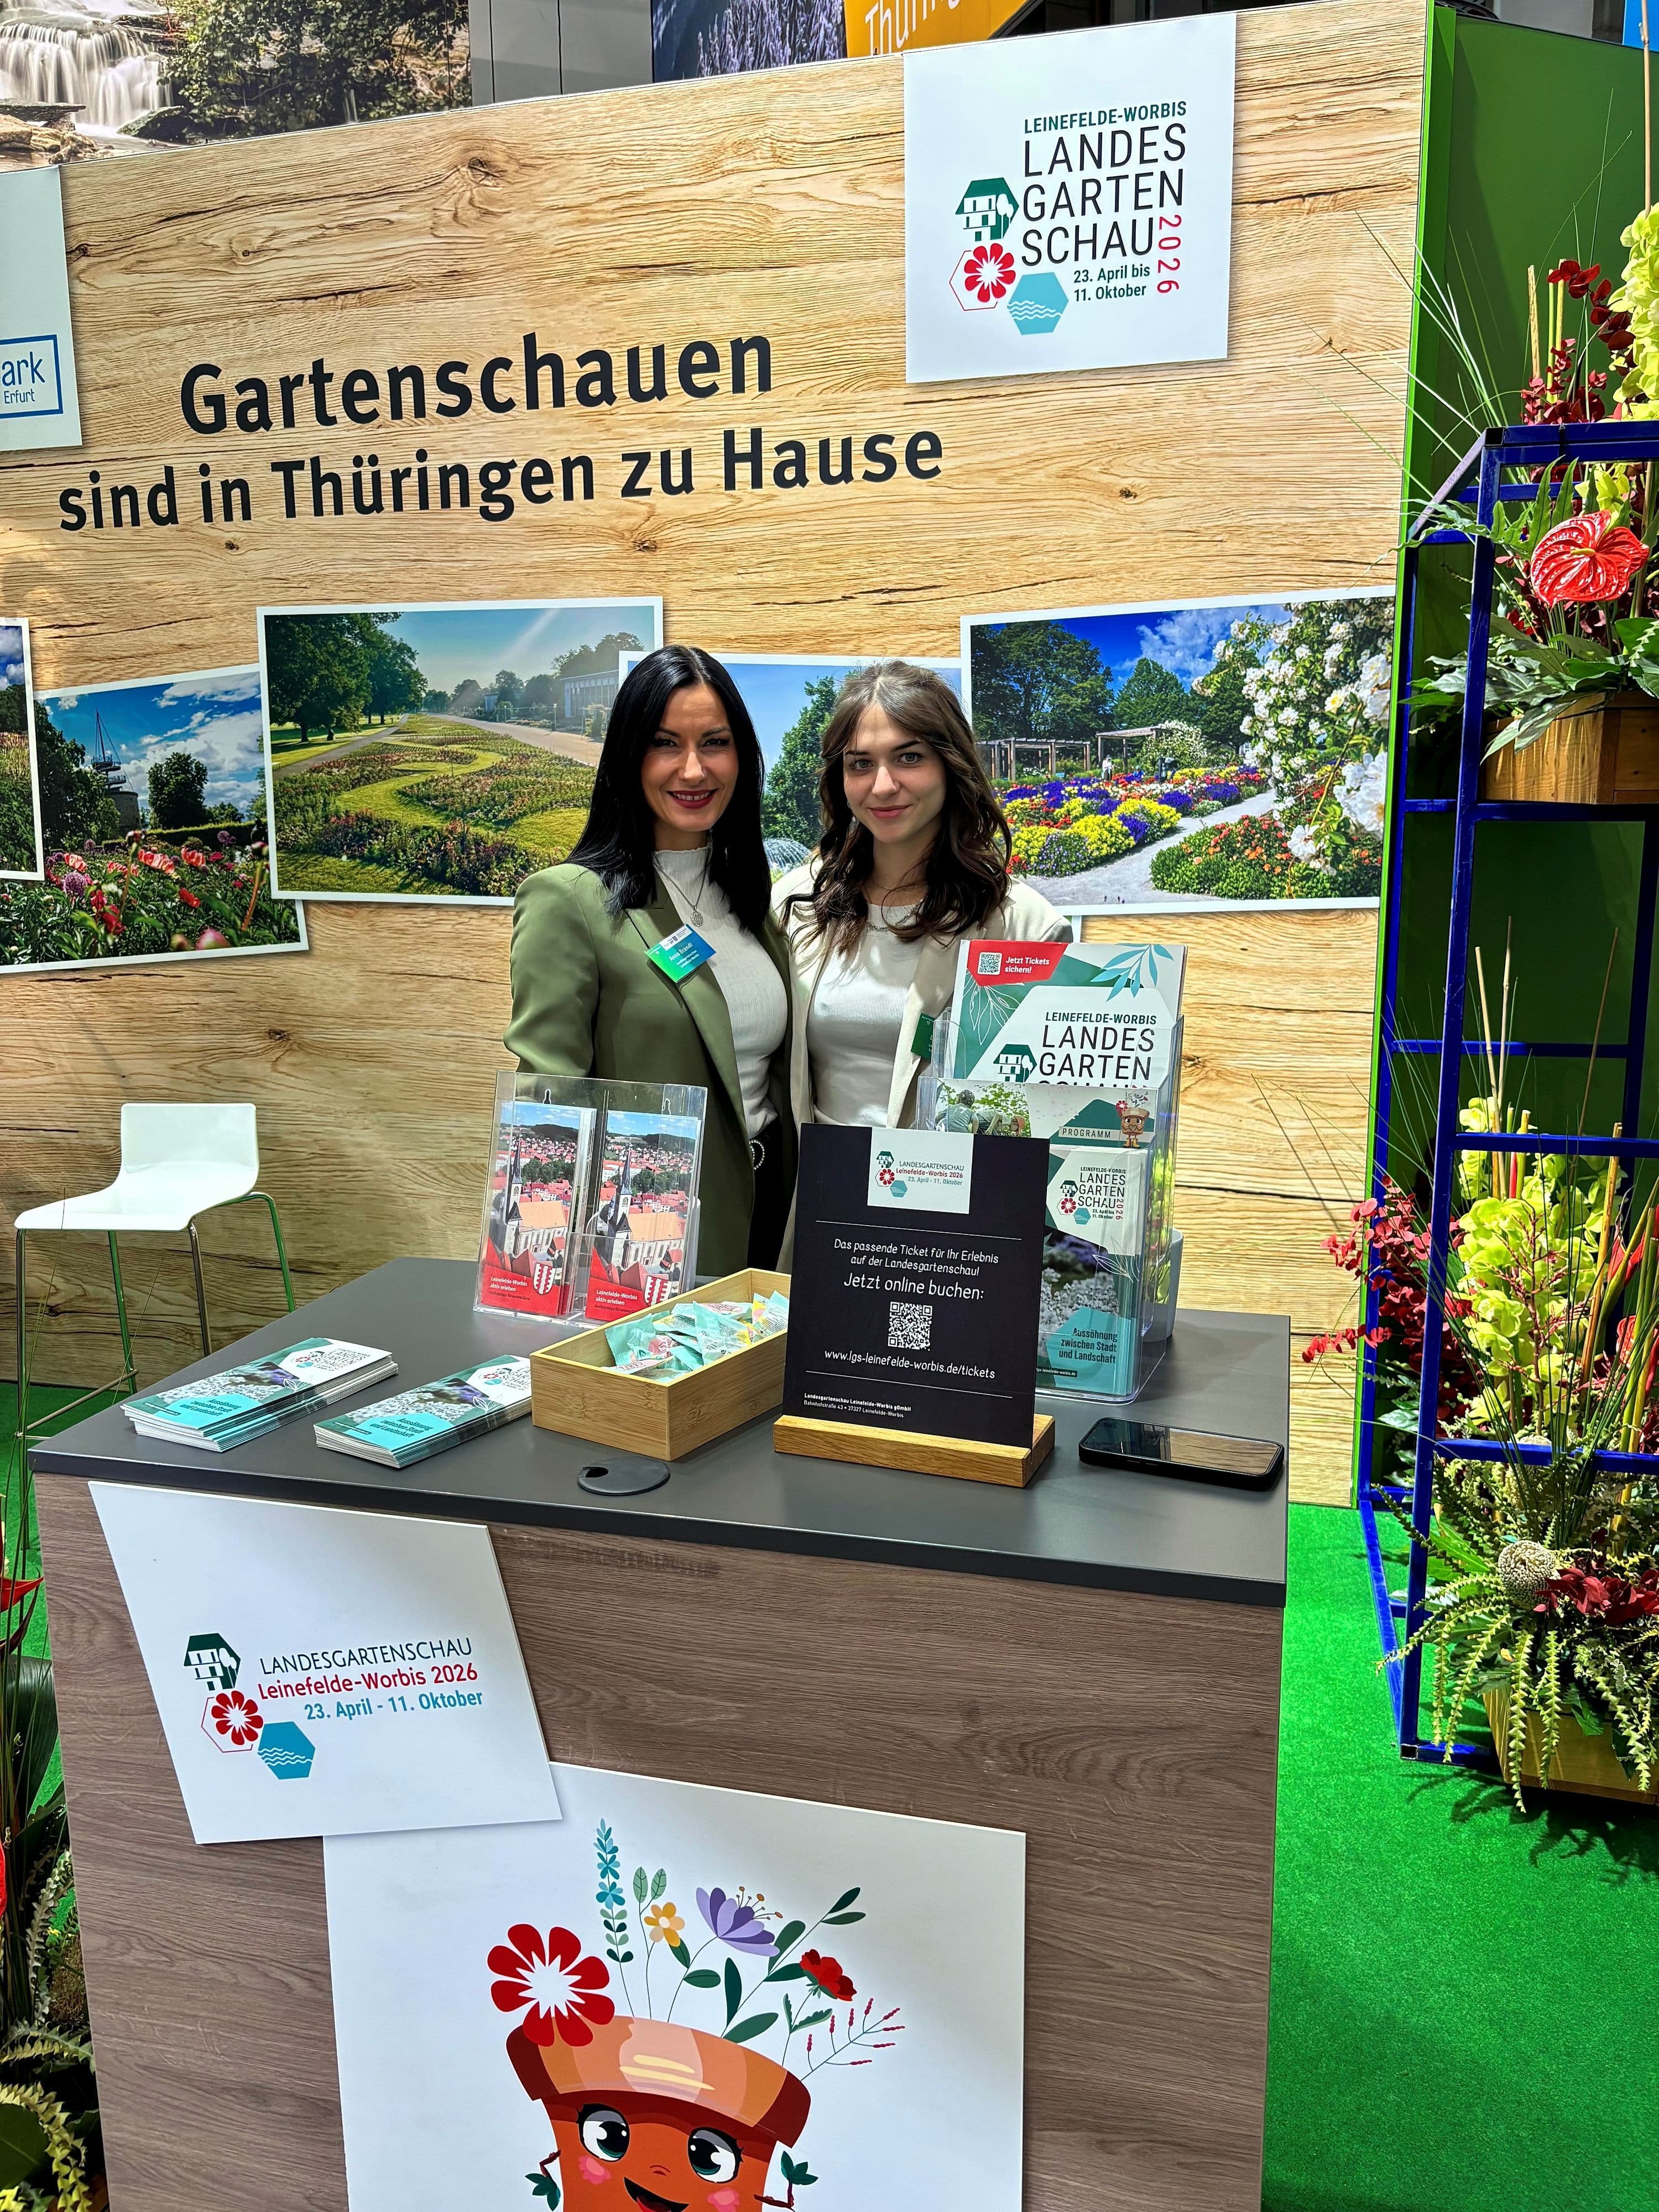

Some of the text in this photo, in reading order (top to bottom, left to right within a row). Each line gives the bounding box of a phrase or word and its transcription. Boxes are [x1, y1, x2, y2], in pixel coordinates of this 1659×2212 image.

[1024, 101, 1187, 133] LEINEFELDE-WORBIS
[1024, 123, 1186, 177] LANDES
[1022, 169, 1183, 222] GARTEN
[1021, 215, 1181, 294] SCHAU 2026
[1073, 264, 1150, 284] 23. April bis
[1074, 284, 1146, 301] 11. Oktober
[181, 332, 773, 434] Gartenschauen
[4, 388, 35, 404] Erfurt
[59, 427, 942, 531] sind in Thüringen zu Hause
[1045, 1011, 1157, 1025] LEINEFELDE-WORBIS
[1042, 1024, 1155, 1052] LANDES
[1039, 1052, 1151, 1081] GARTEN
[1062, 1128, 1111, 1139] PROGRAMM
[896, 1168, 948, 1177] Leinefelde-Worbis
[899, 1161, 964, 1171] LANDESGARTENSCHAU
[1080, 1172, 1125, 1185] LANDES
[1079, 1184, 1124, 1197] GARTEN
[1078, 1196, 1124, 1220] SCHAU 2026
[834, 1238, 999, 1264] Das passende Ticket für Ihr Erlebnis
[851, 1255, 980, 1276] auf der Landesgartenschau!
[491, 1276, 528, 1286] Leinefelde-Worbis
[843, 1272, 984, 1300] Jetzt online buchen:
[596, 1289, 638, 1300] Leinefelde-Worbis
[1061, 1338, 1117, 1352] zwischen Stadt
[1073, 1327, 1118, 1343] Aussöhnung
[825, 1350, 995, 1379] www.lgs-leinefelde-worbis.de/tickets
[1059, 1350, 1116, 1364] und Landschaft
[804, 1392, 849, 1404] Landesgartenschau
[850, 1399, 893, 1410] Leinefelde-Worbis
[804, 1400, 837, 1409] Bahnhofstraße
[862, 1407, 904, 1418] Leinefelde-Worbis
[260, 1637, 472, 1675] LANDESGARTENSCHAU
[258, 1662, 478, 1700] Leinefelde-Worbis 2026
[304, 1703, 331, 1720] 23.
[336, 1698, 373, 1721] April
[388, 1695, 415, 1713] 11.
[418, 1689, 483, 1710] Oktober
